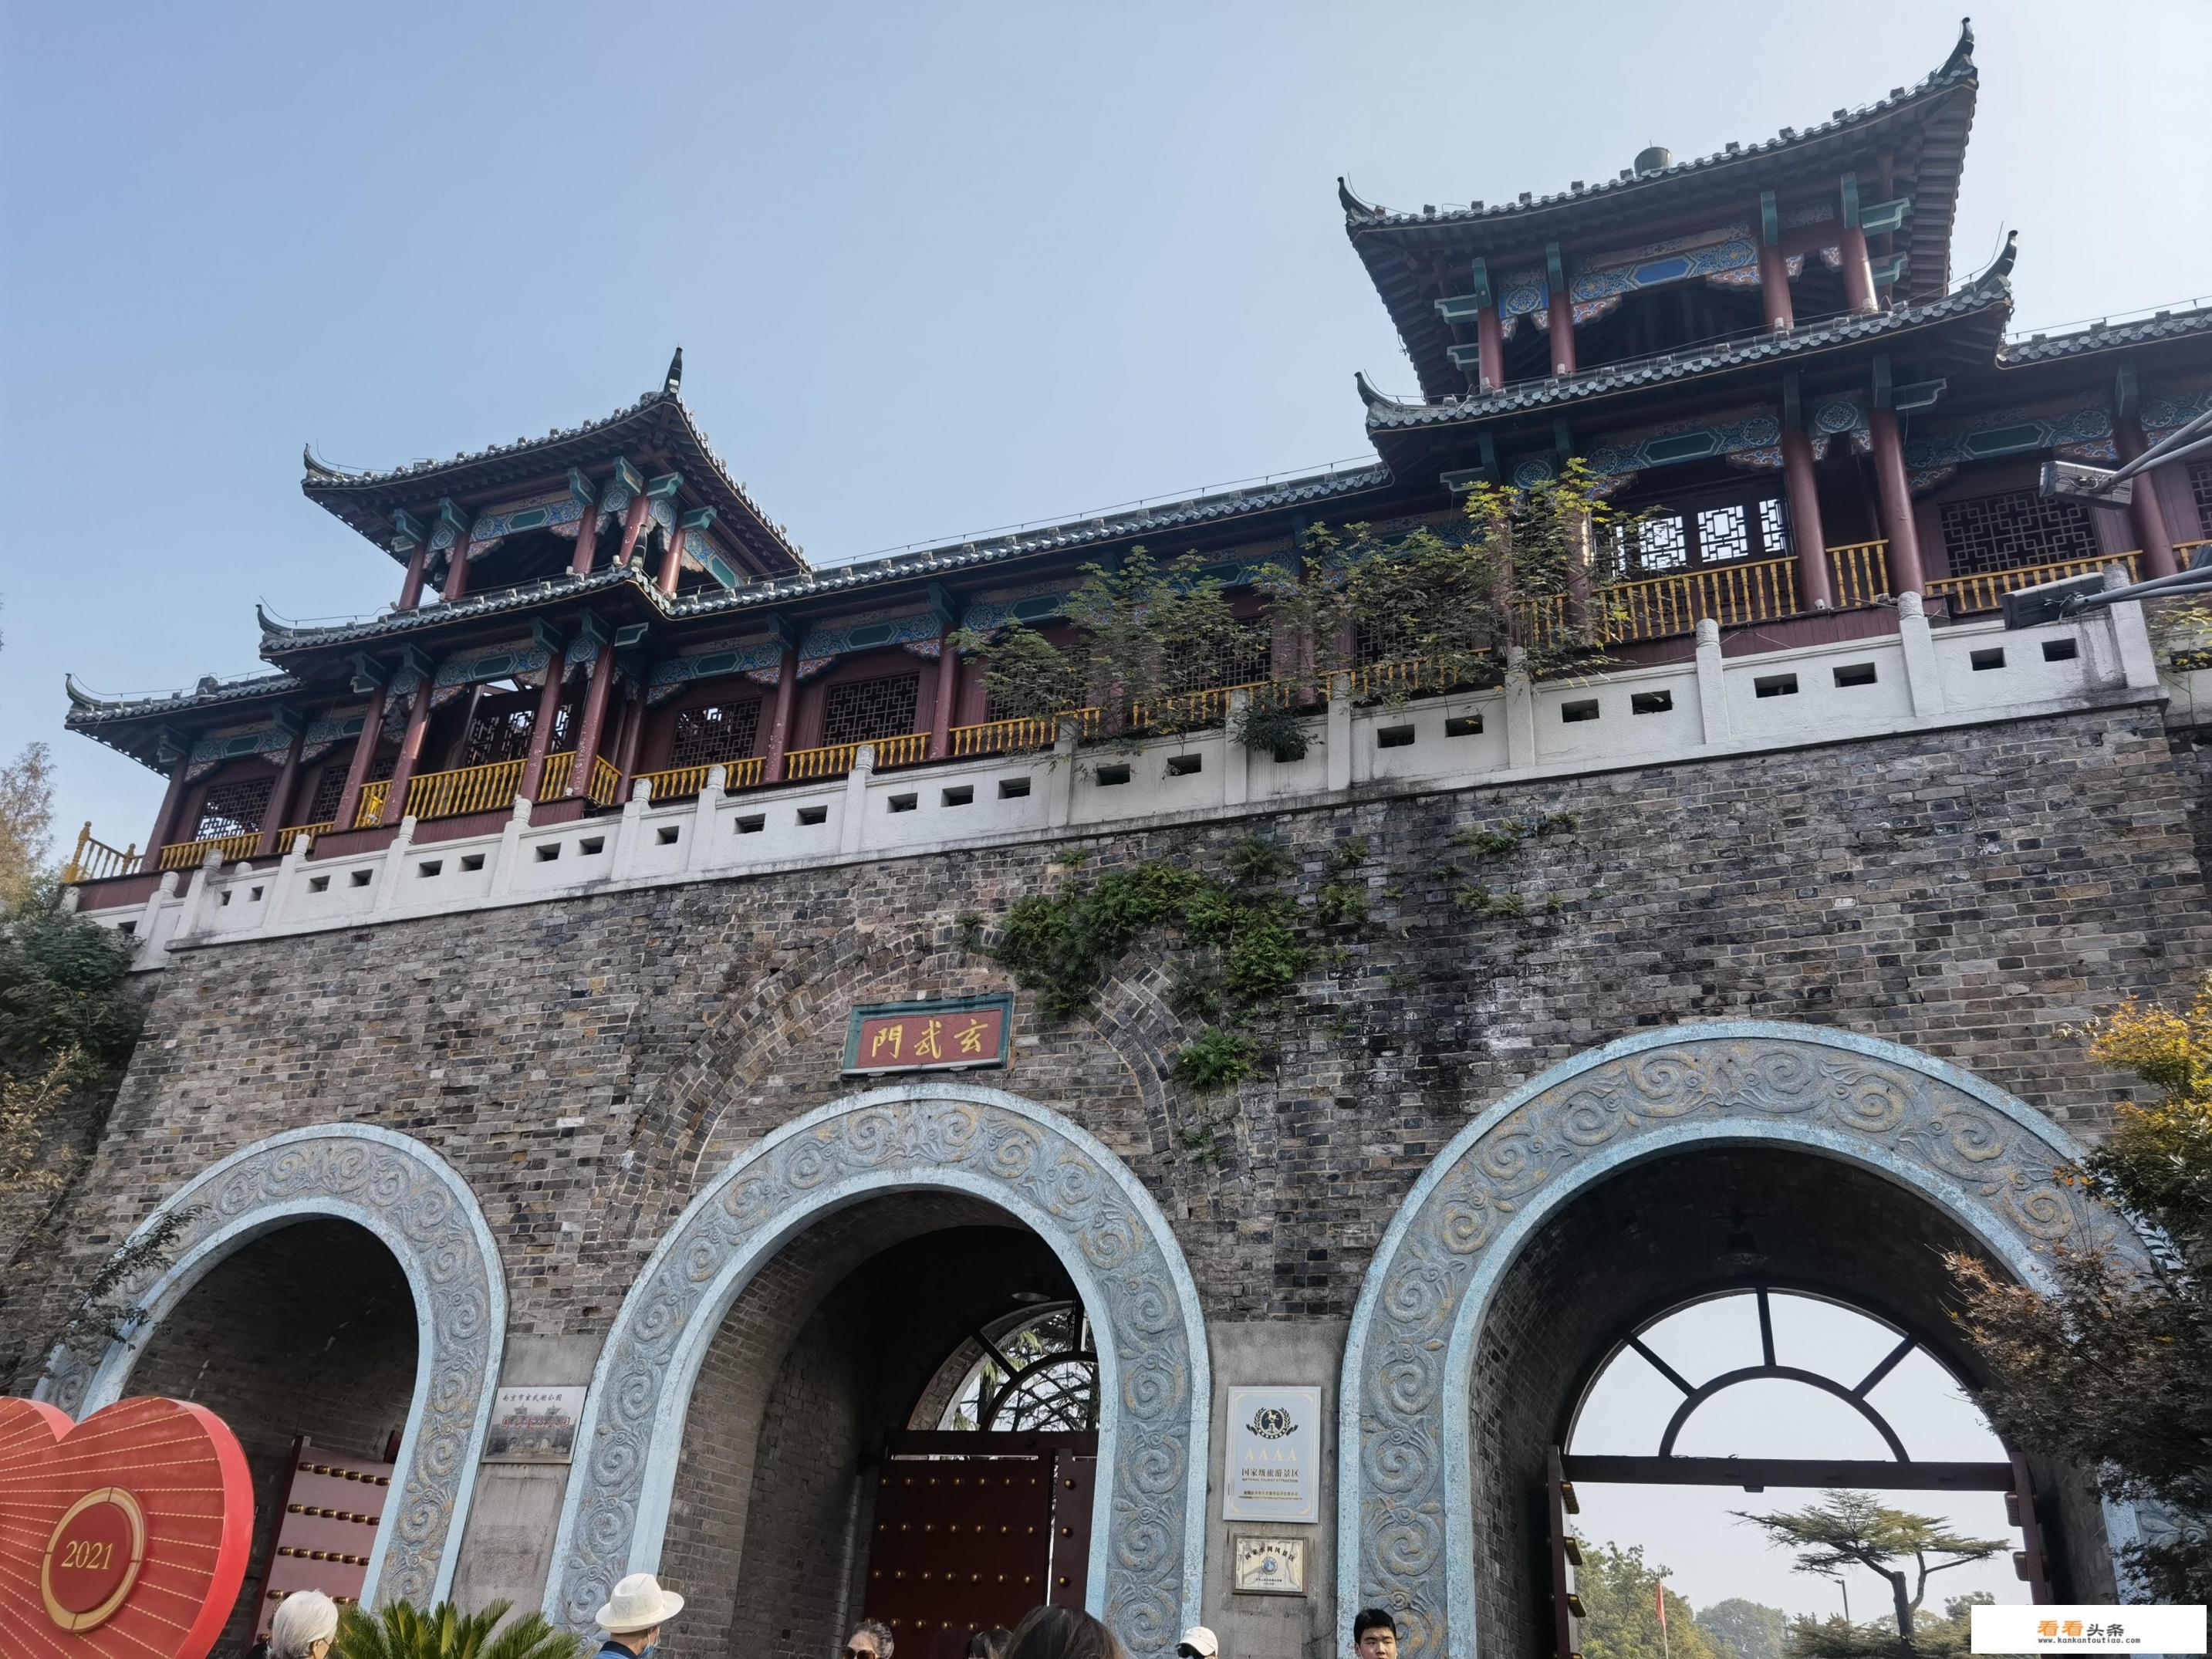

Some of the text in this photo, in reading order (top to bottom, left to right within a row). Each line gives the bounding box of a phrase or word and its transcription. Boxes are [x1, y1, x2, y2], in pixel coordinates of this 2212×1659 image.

[1241, 1467, 1299, 1478] 国家级旅游景区
[61, 1540, 113, 1569] 2021
